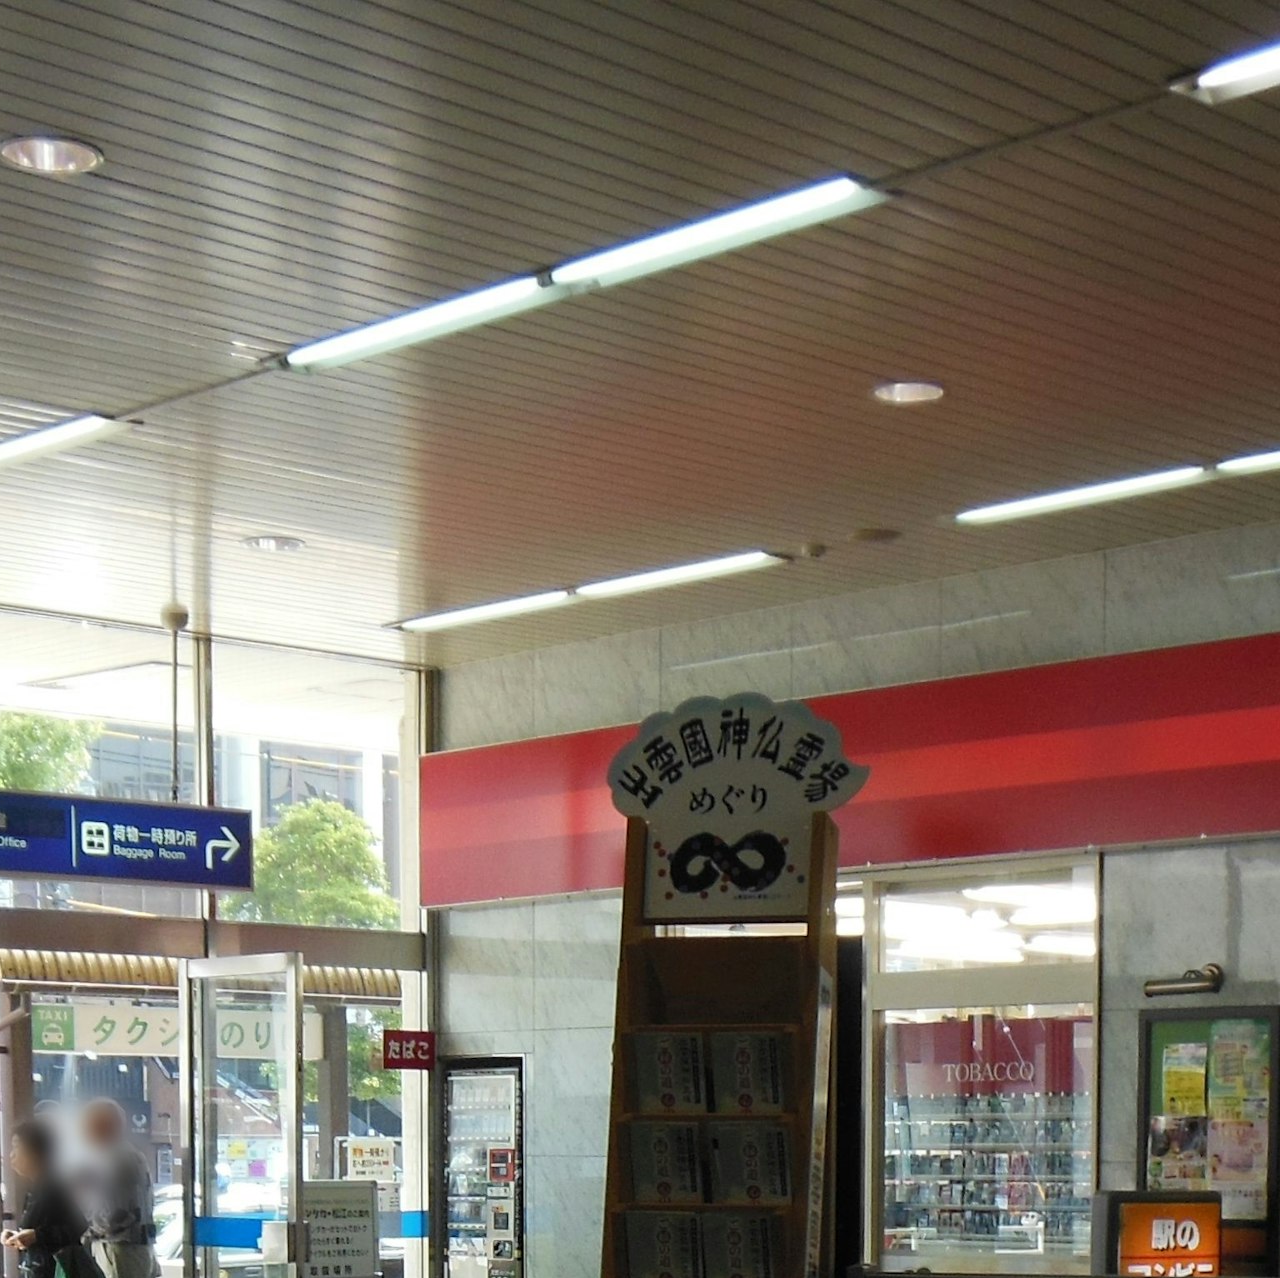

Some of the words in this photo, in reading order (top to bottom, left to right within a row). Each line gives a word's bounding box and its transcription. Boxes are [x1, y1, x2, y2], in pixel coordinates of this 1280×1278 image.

[689, 785, 768, 814] めぐり
[112, 824, 197, 847] 荷物一時預り所
[113, 845, 154, 859] Baggage
[159, 847, 186, 860] Room
[37, 1009, 67, 1021] TAXI
[388, 1040, 430, 1059] たばこ
[942, 1062, 1034, 1084] TOBACCO
[1151, 1219, 1200, 1251] 駅の
